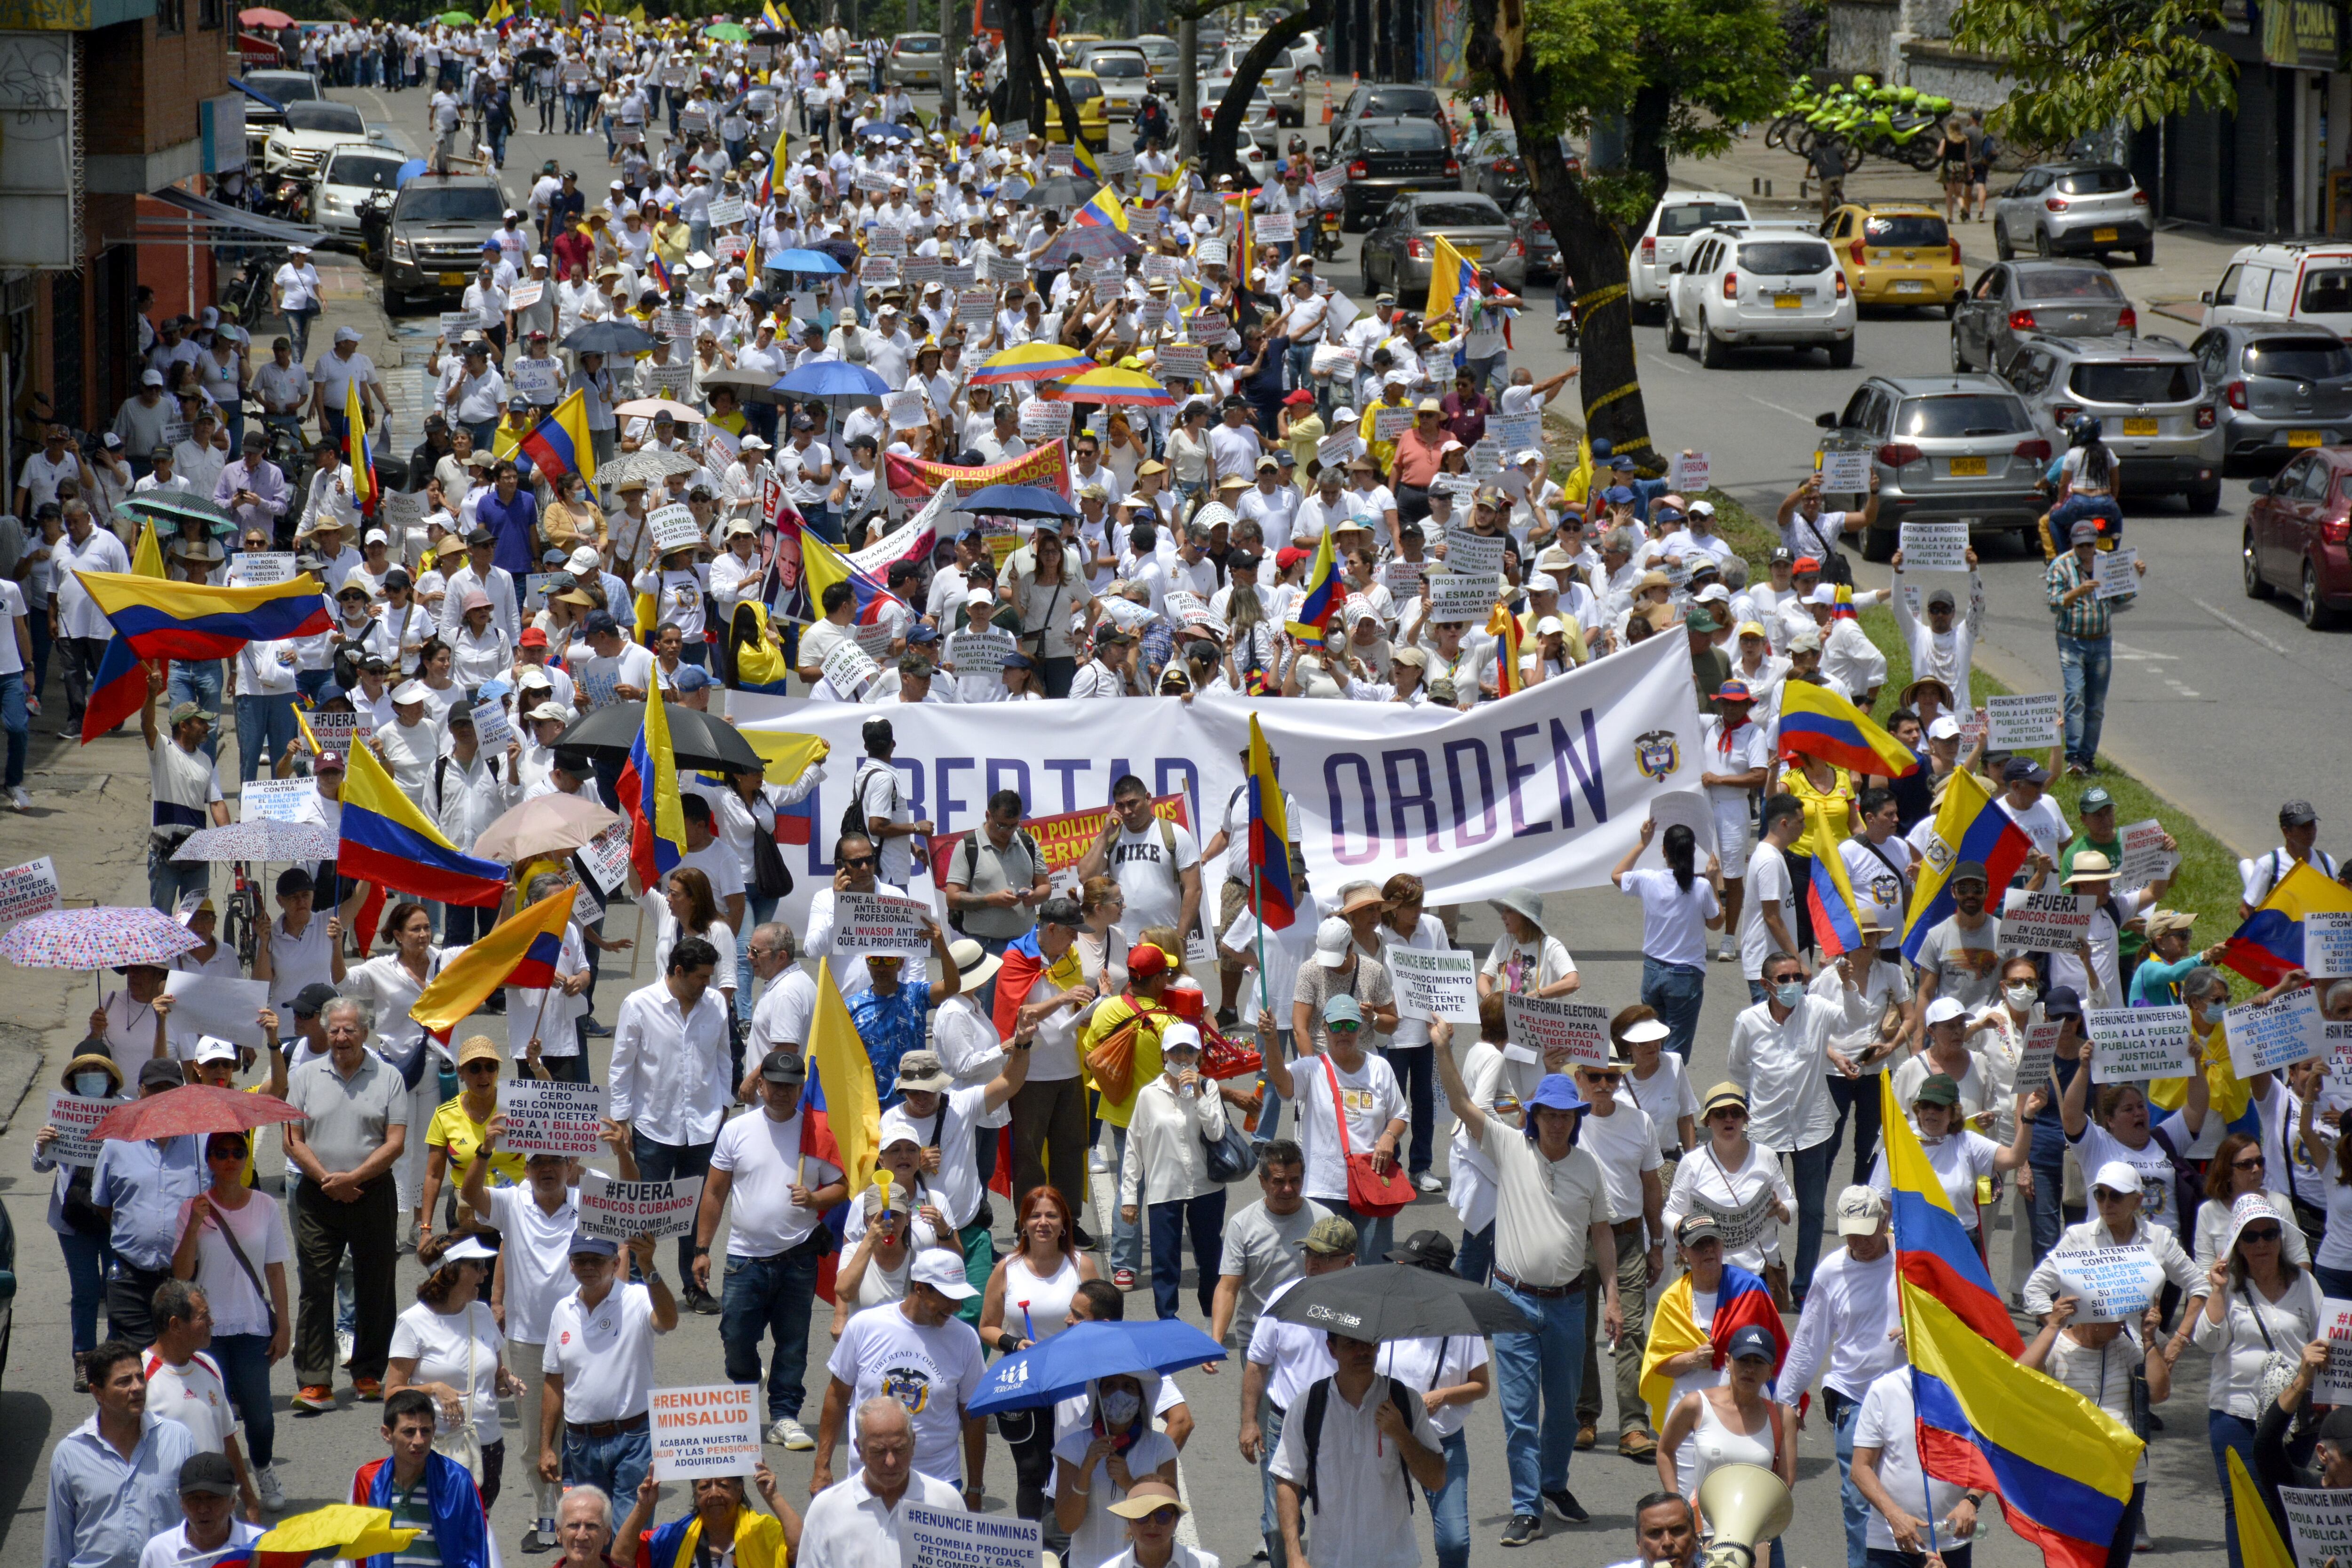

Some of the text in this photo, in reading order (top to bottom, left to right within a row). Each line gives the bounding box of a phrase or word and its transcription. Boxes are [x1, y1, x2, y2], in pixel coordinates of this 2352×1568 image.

[925, 463, 964, 479] JUICIO
[1037, 445, 1059, 462] LOS
[2025, 695, 2057, 705] MINDEFENSA
[315, 714, 357, 726] #FUERA
[1324, 707, 1607, 866] ORDEN
[1115, 843, 1160, 865] NIKE
[877, 897, 926, 910] PANDILLERO
[884, 905, 900, 914] QUE
[854, 914, 913, 924] PROFESIONAL,
[856, 927, 893, 936] INVASOR
[838, 937, 928, 948] QUE AL PROPIETARIO
[1393, 951, 1470, 971] #RENUNCIE IRENE MINMINAS
[1396, 970, 1472, 985] DESCONOCIMIENTO
[1406, 990, 1465, 1003] INCOMPETENTE
[1414, 1001, 1463, 1012] IGNORANTE.
[1508, 995, 1607, 1019] #SIN REFORMA ELECTORAL
[1519, 1014, 1597, 1031] PELIGRO PARA
[2090, 1010, 2187, 1026] #RENUNCIE MINDEFENSA
[1525, 1032, 1592, 1047] LA LIBERTAD
[1529, 1025, 1604, 1040] DEMOCRACIA,
[2093, 1030, 2118, 1040] ODIA
[2148, 1026, 2189, 1035] FUERZA
[2102, 1037, 2146, 1051] PÚBLICA
[2170, 1036, 2183, 1045] LA
[2119, 1050, 2166, 1061] JUSTICIA
[2104, 1060, 2182, 1074] PENAL MILITAR
[509, 1080, 599, 1094] #SI MATRICULA
[540, 1091, 572, 1100] CERO
[532, 1101, 597, 1112] CONDONAR
[510, 1110, 596, 1121] DEUDA ICETEX
[528, 1120, 537, 1129] A
[553, 1121, 599, 1131] BILLÓN
[509, 1130, 596, 1142] PARA 100.000
[508, 1139, 596, 1152] PANDILLEROS
[606, 1182, 674, 1202] #FUERA
[582, 1195, 693, 1214] MÉDICOS CUBANOS
[581, 1221, 626, 1238] TENEMOS
[603, 1215, 671, 1231] EN COLOMBIA
[2056, 1245, 2145, 1259] #AHORA ATENTAN
[2082, 1256, 2127, 1267] CONTRA:
[2115, 1260, 2154, 1272] PENSIÓN,
[2096, 1270, 2125, 1280] BANCO
[2098, 1286, 2141, 1297] SU FINCA,
[2107, 1294, 2149, 1306] EMPRESA,
[1322, 1307, 1361, 1325] Sanitas
[871, 1351, 912, 1374] LIBERTAD
[922, 1356, 944, 1384] ORDEN
[653, 1390, 750, 1409] #RENUNCIE
[658, 1409, 748, 1429] MINSALUD
[660, 1435, 747, 1447] ACABARA NUESTRA
[653, 1449, 673, 1458] SALUD
[707, 1445, 759, 1455] PENSIONES
[675, 1457, 735, 1467] ADQUIRIDAS
[908, 1509, 1037, 1542] #RENUNCIE MINMINAS
[914, 1533, 1034, 1559] COLOMBIA PRODUCE
[921, 1545, 979, 1563] PETROLEO
